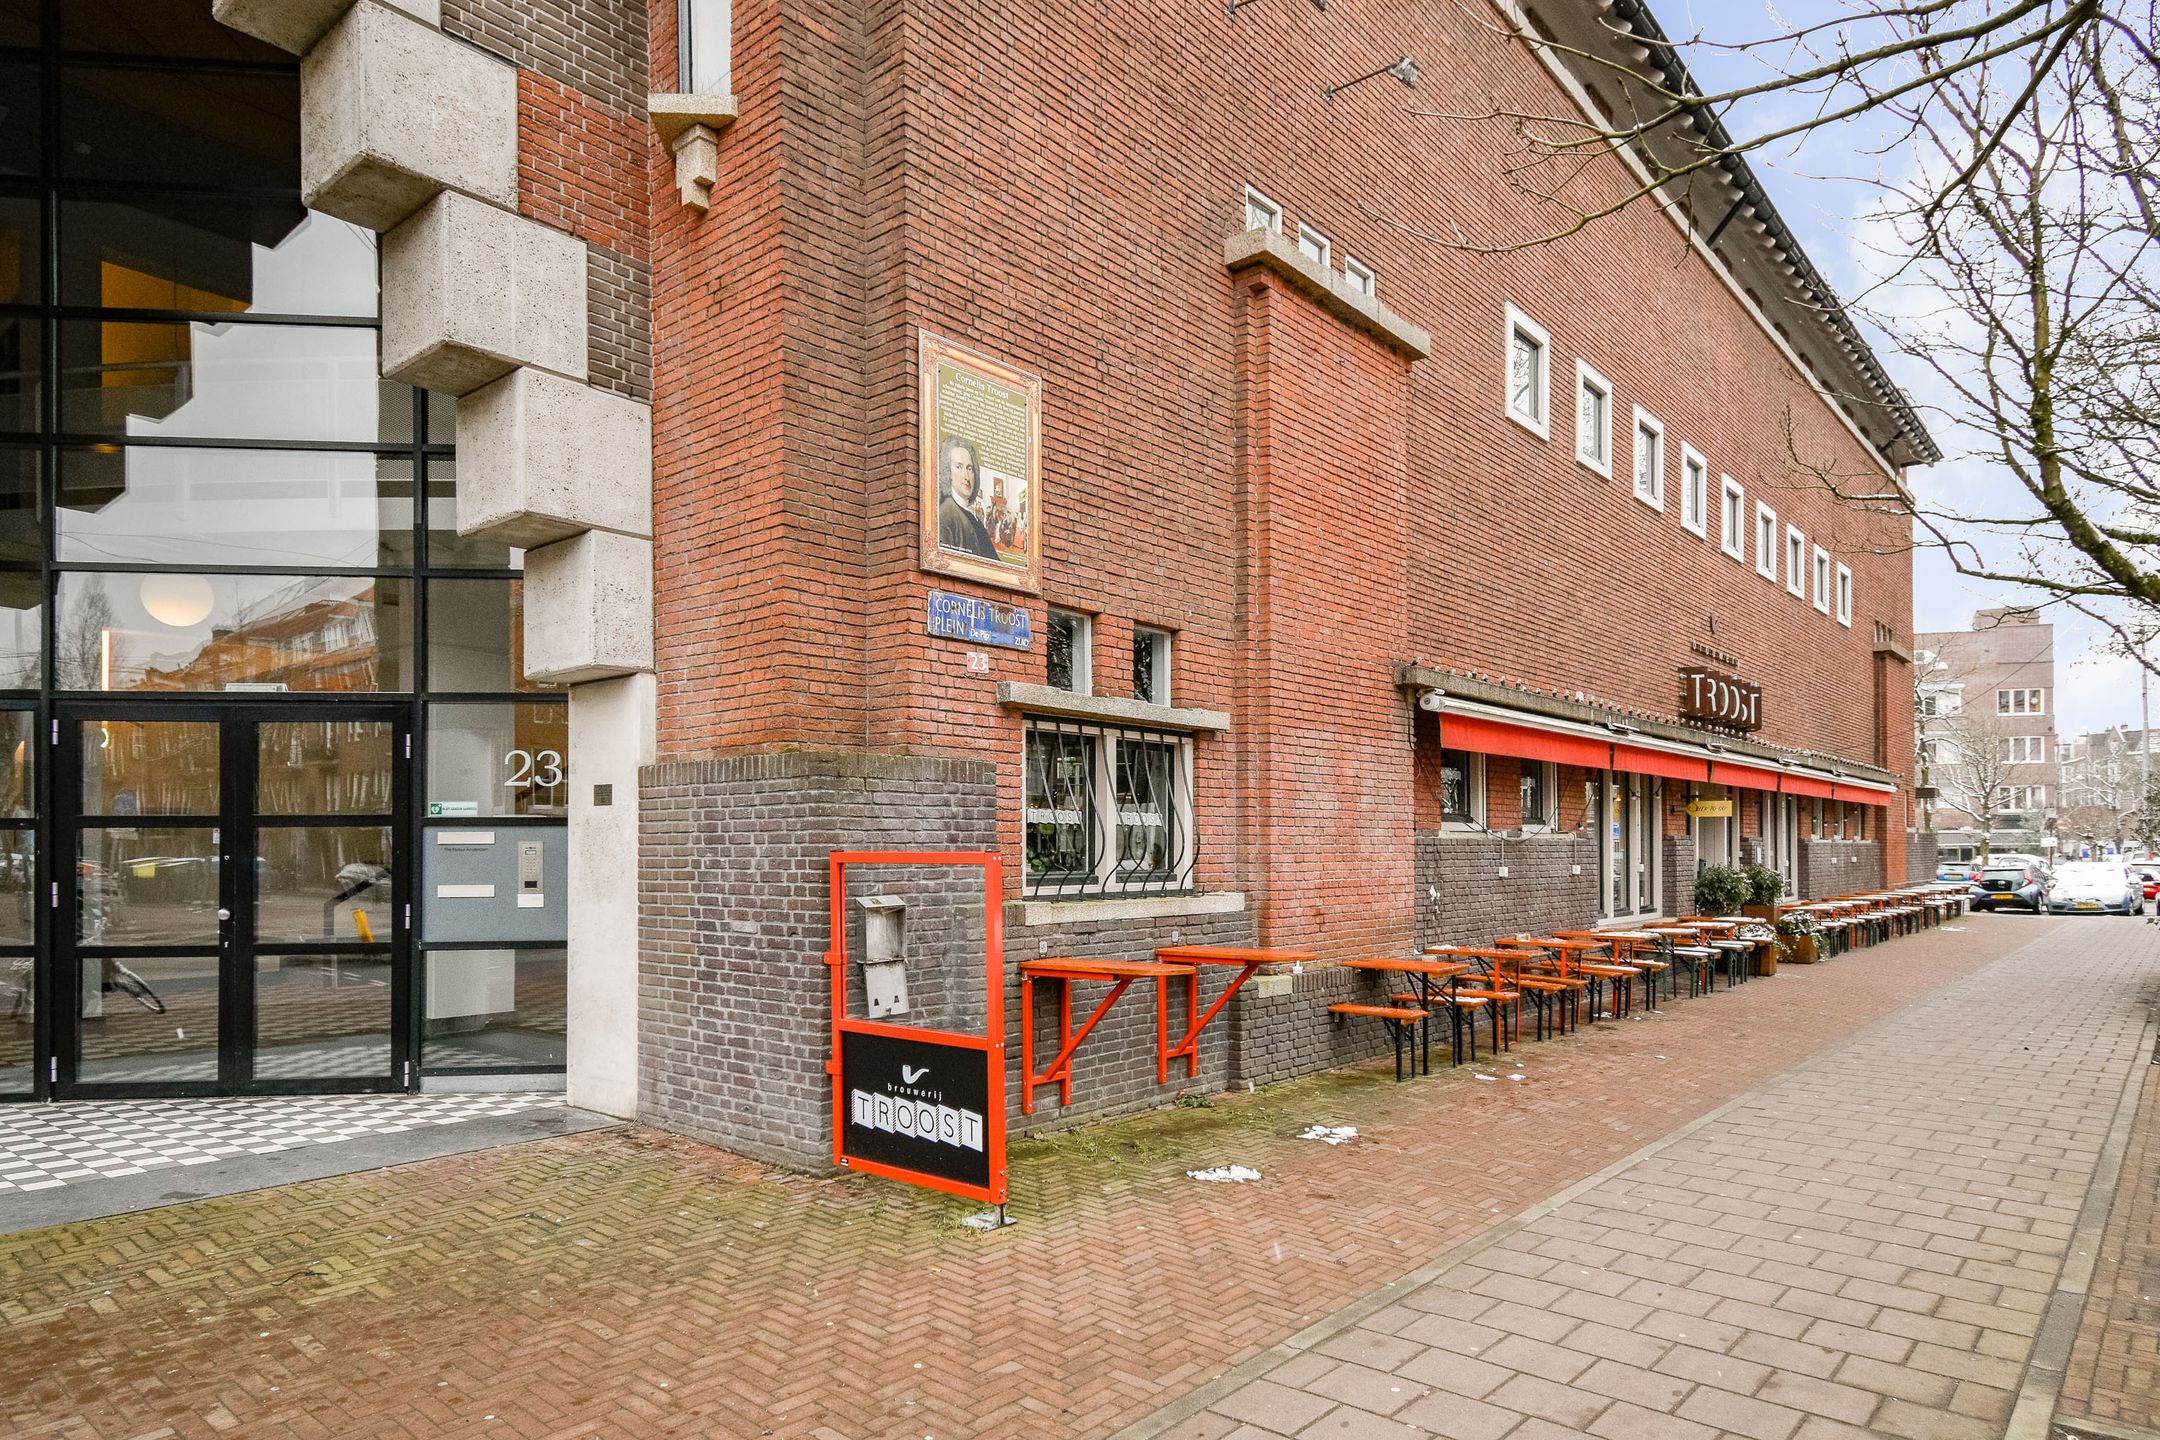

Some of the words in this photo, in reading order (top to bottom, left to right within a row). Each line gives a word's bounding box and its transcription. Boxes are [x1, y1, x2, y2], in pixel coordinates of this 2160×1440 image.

[956, 372, 985, 391] Cornelis
[987, 384, 1009, 399] Troost
[935, 598, 986, 620] CORNELIS
[989, 607, 1026, 628] TROOST
[935, 616, 965, 635] PLEIN
[970, 628, 979, 638] De
[1014, 637, 1029, 647] ZUID
[971, 654, 986, 670] 23
[503, 749, 563, 787] 23
[887, 1082, 942, 1101] brouwerij
[857, 1096, 979, 1142] TROOST
